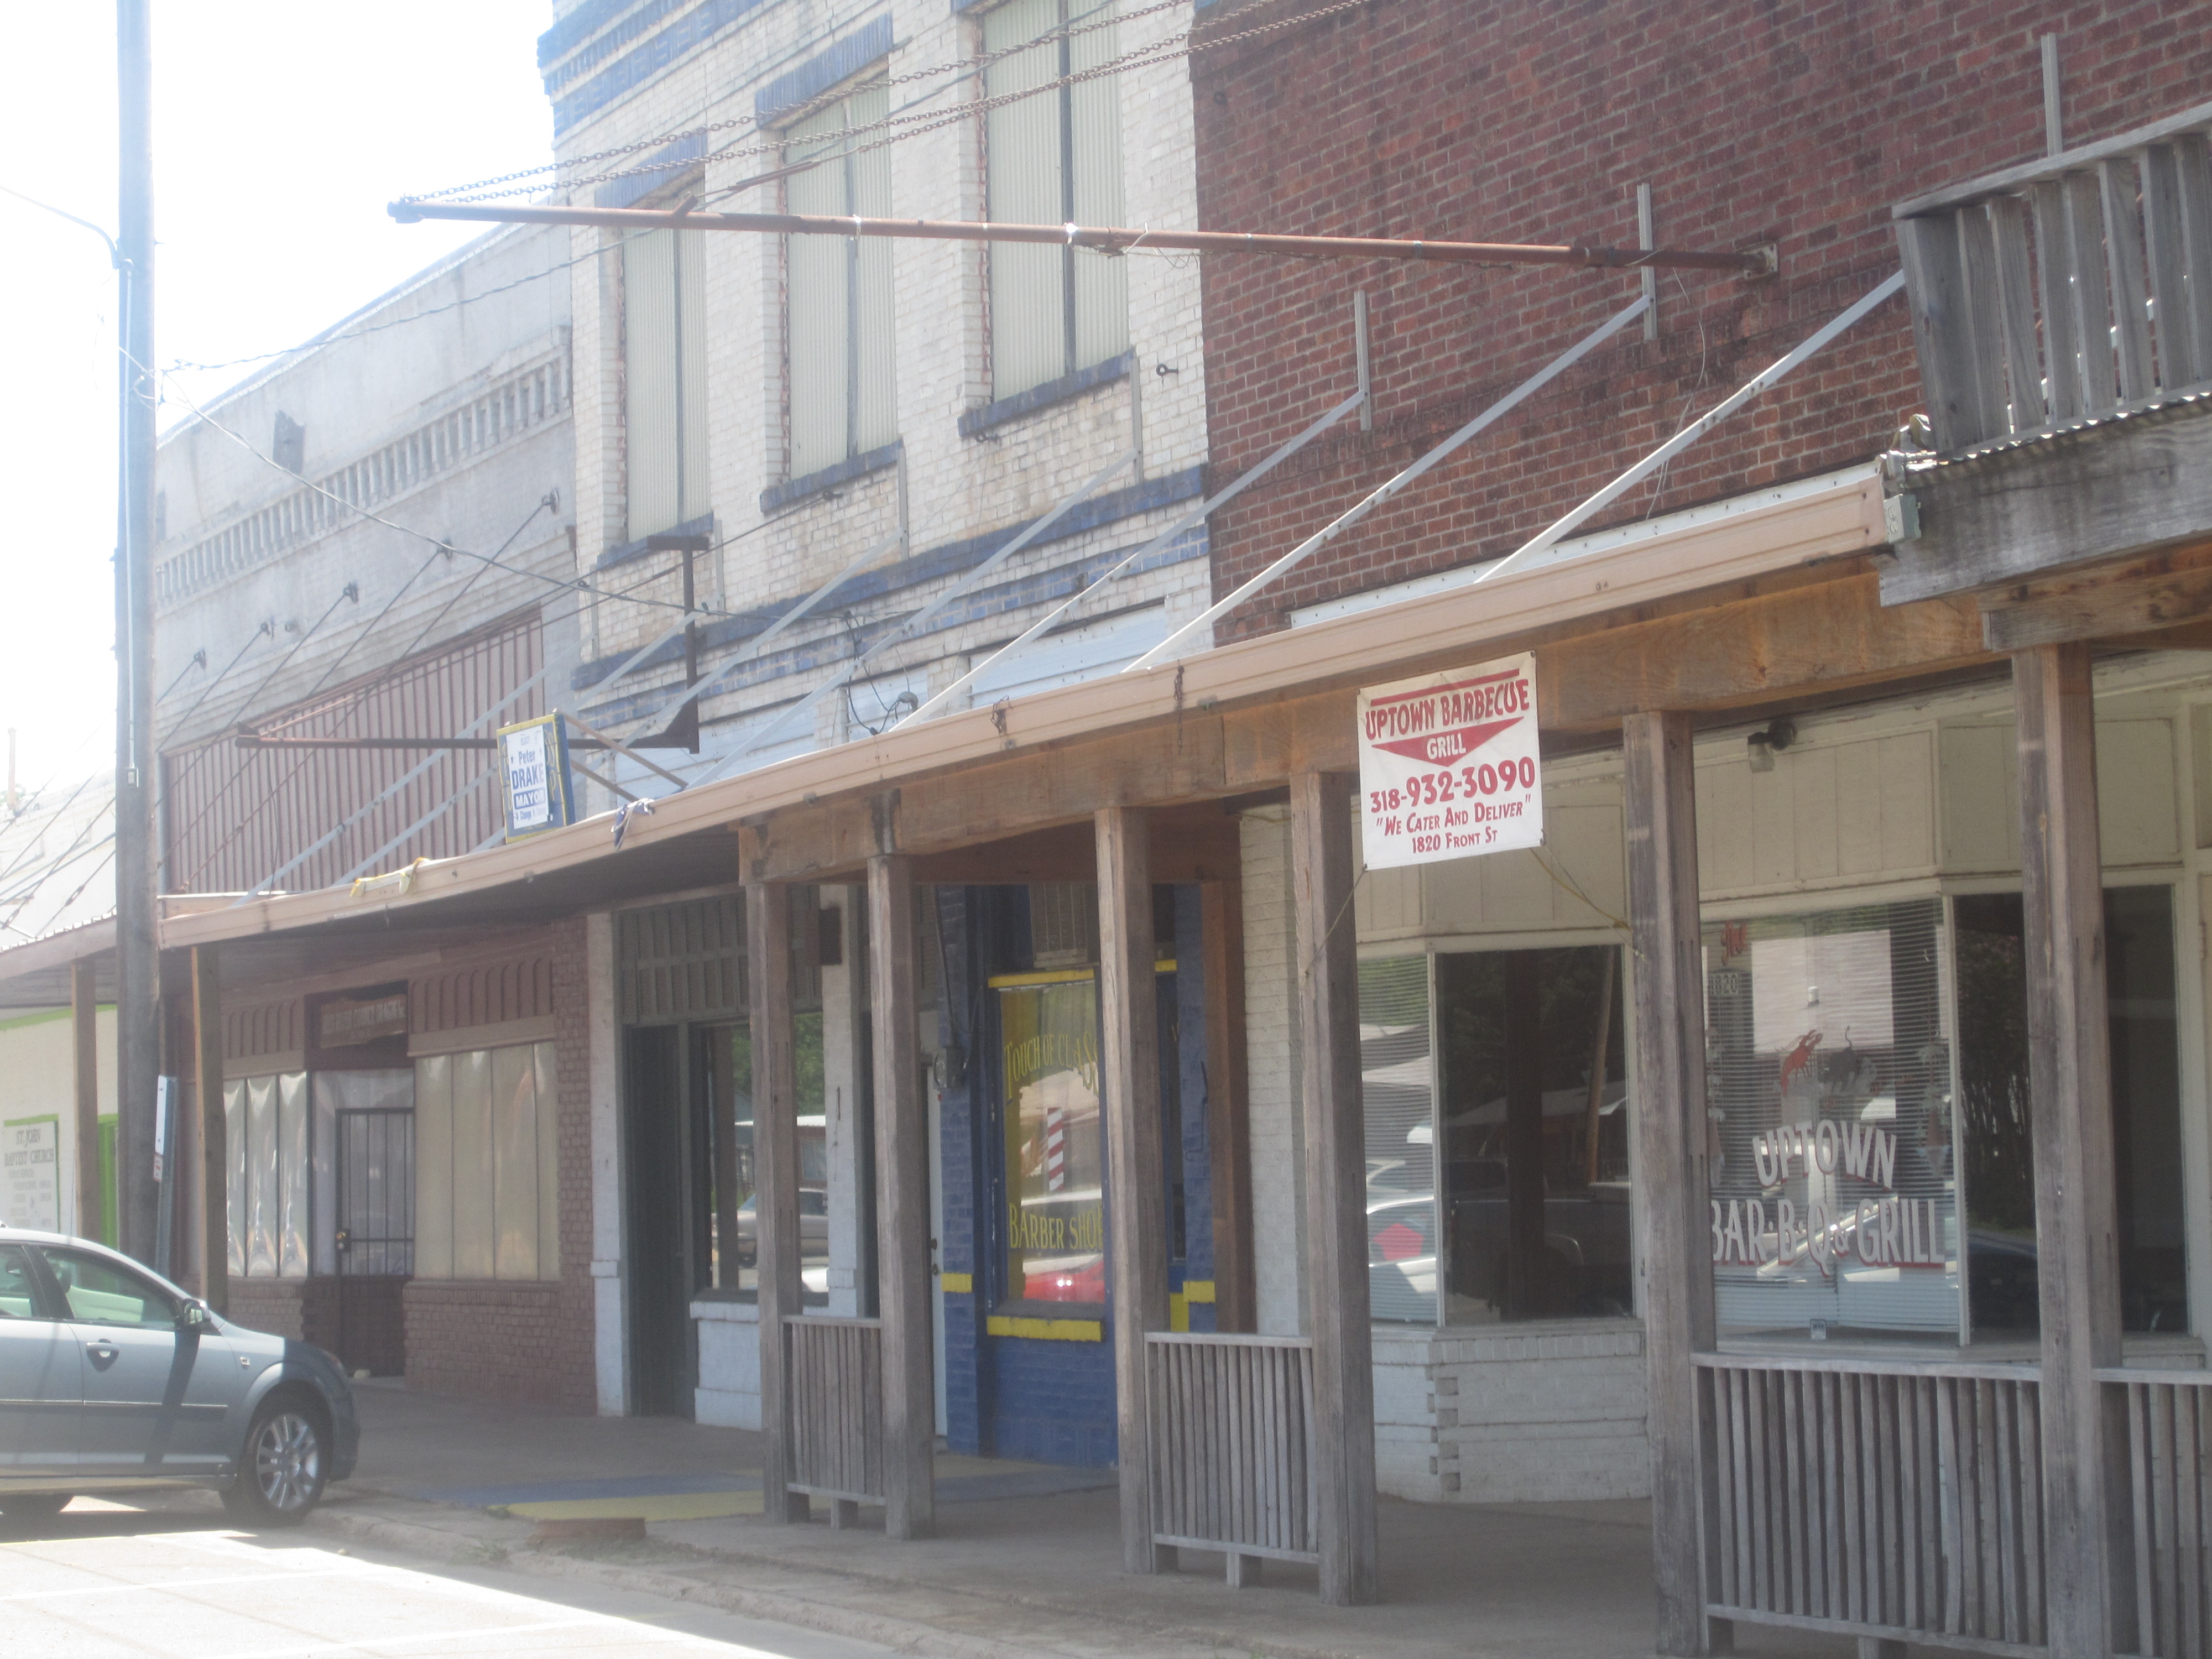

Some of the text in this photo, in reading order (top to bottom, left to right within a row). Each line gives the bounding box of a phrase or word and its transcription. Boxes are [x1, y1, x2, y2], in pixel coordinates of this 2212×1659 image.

[1365, 679, 1530, 740] UPTOWN BARBECUE
[518, 750, 535, 765] Peter
[1426, 733, 1466, 760] GRILL
[512, 763, 545, 790] DRAKE
[1370, 757, 1535, 813] 318-932-3090
[515, 790, 545, 807] MAYOR
[1412, 836, 1441, 853] 1820
[1043, 1034, 1055, 1066] OF
[1752, 1119, 1897, 1192] UPTOWN
[1009, 1203, 1065, 1249] BARBER
[1855, 1198, 1945, 1269] GRILL
